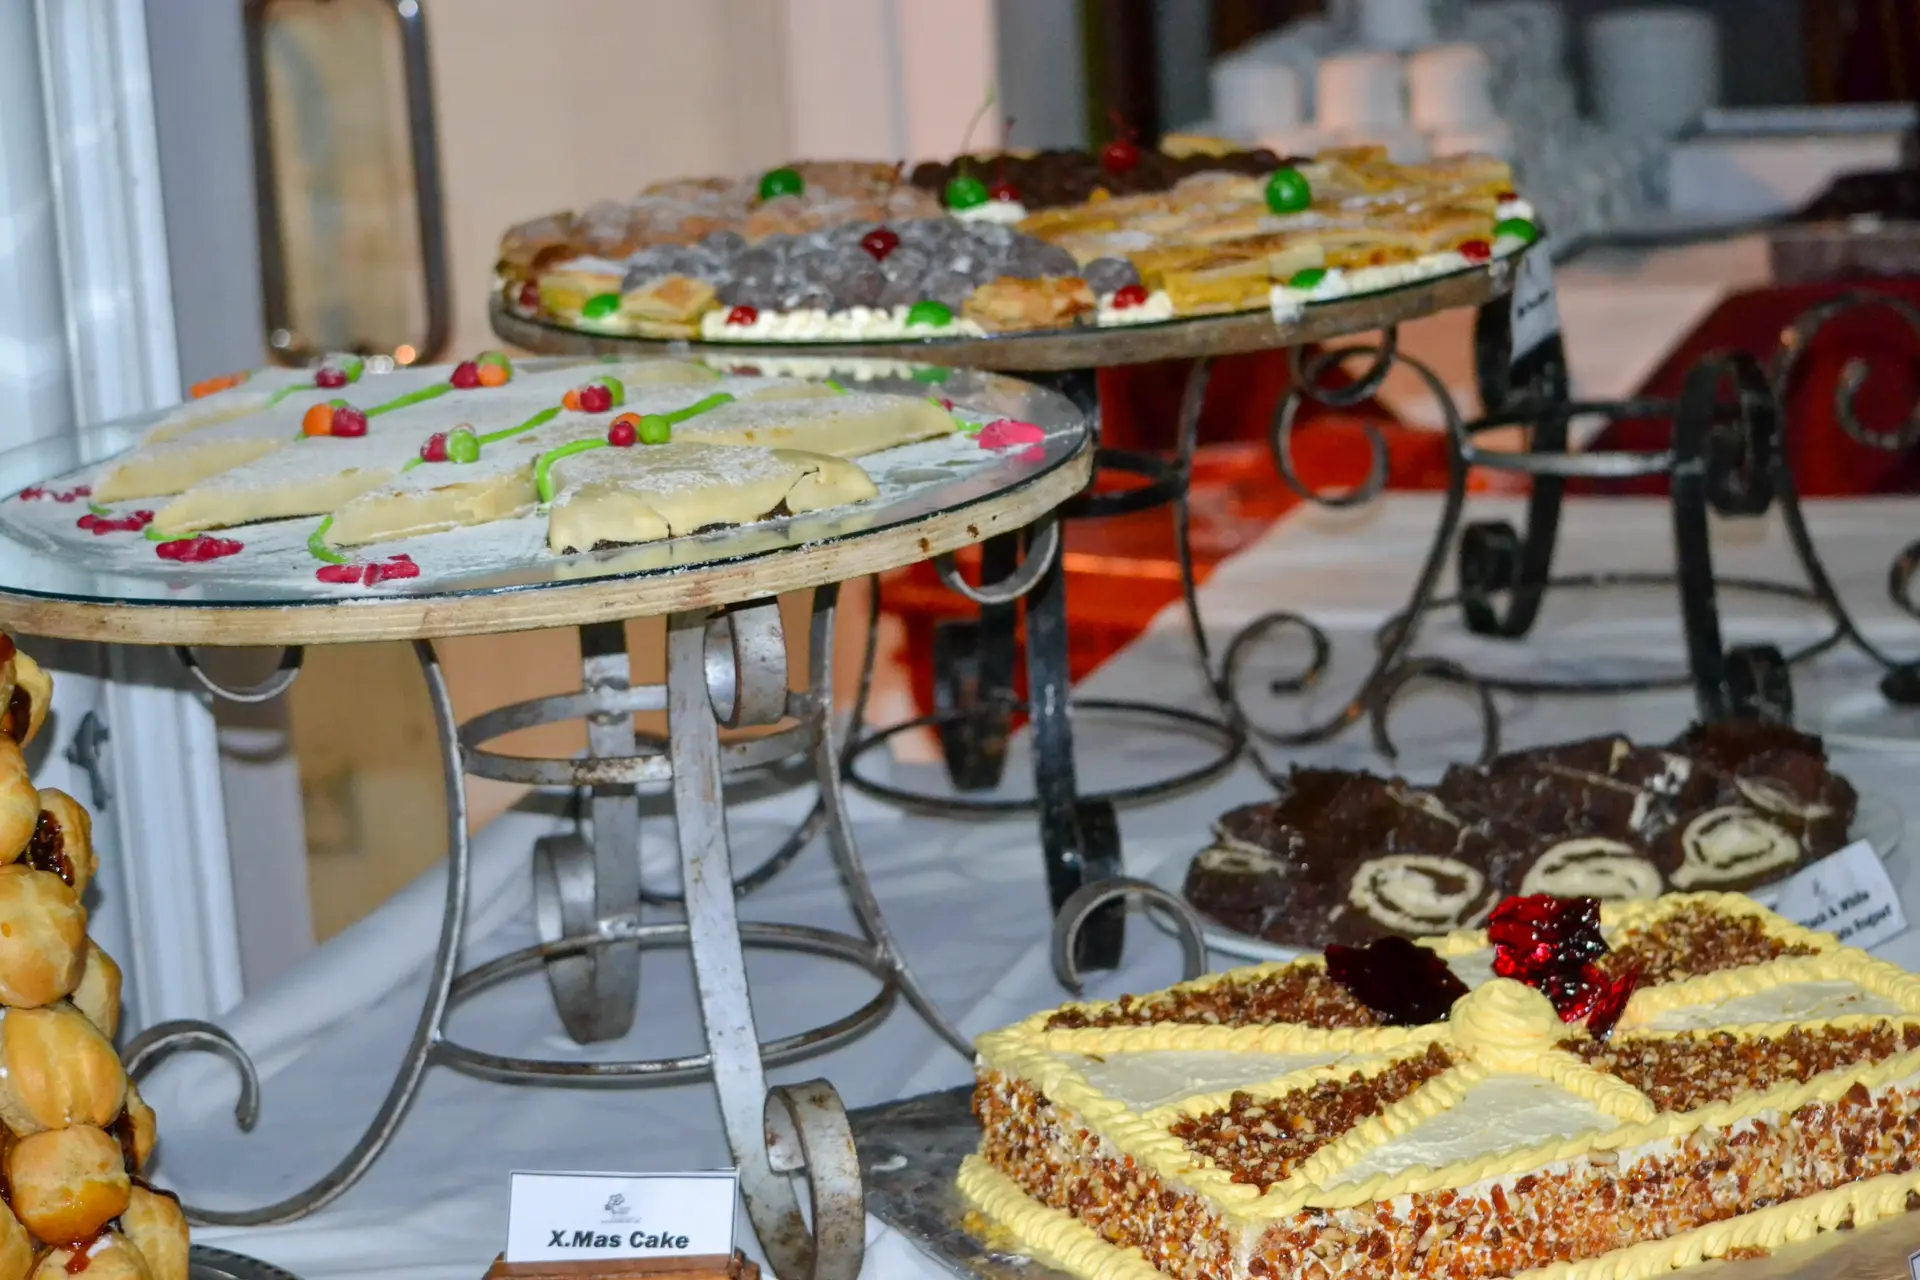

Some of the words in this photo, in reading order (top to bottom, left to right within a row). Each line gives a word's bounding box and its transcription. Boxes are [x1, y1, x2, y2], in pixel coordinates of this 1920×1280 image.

[1840, 891, 1869, 911] White
[547, 1229, 622, 1249] X.Mas
[629, 1230, 690, 1249] Cake
